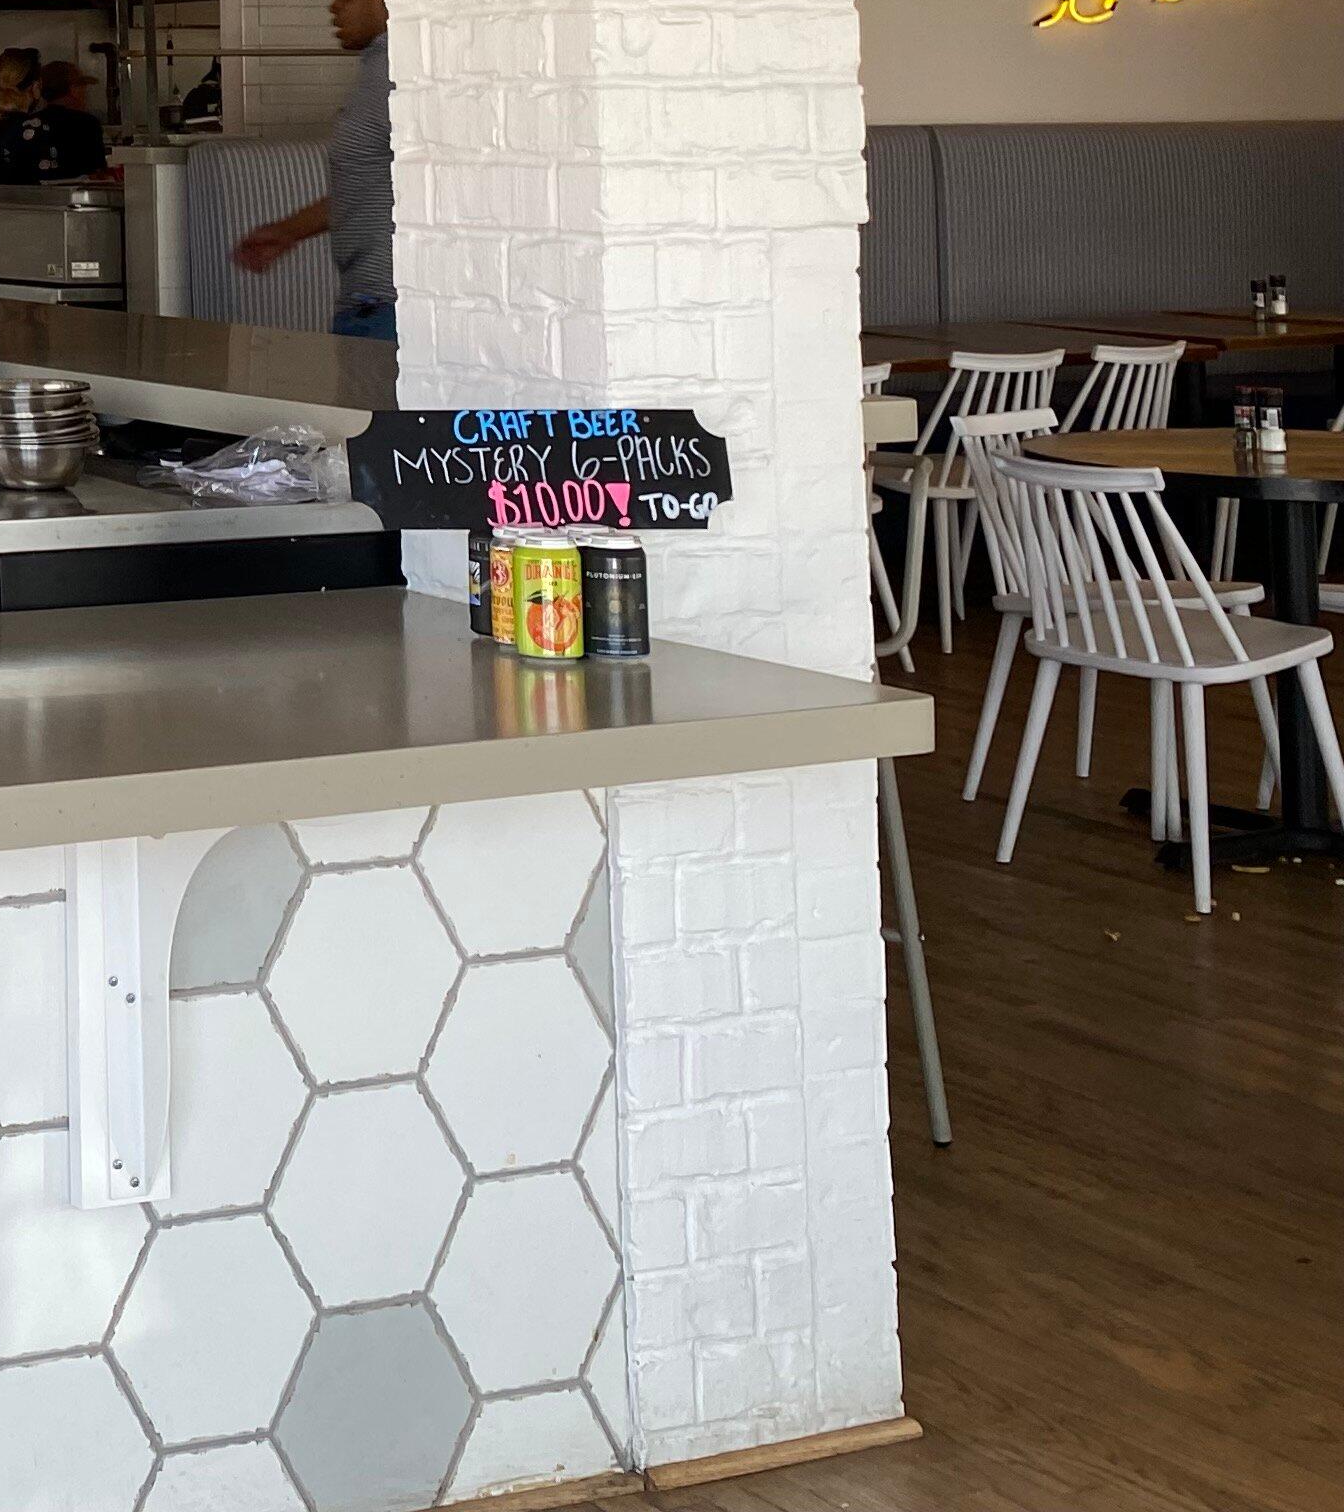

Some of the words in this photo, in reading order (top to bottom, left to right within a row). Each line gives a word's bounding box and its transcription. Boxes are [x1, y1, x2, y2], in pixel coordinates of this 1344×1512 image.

[453, 409, 558, 445] CRAFT
[569, 409, 640, 439] BEER
[393, 444, 552, 486] MYSTERY
[571, 435, 712, 481] 6-PACKS
[487, 479, 631, 527] $10.00!
